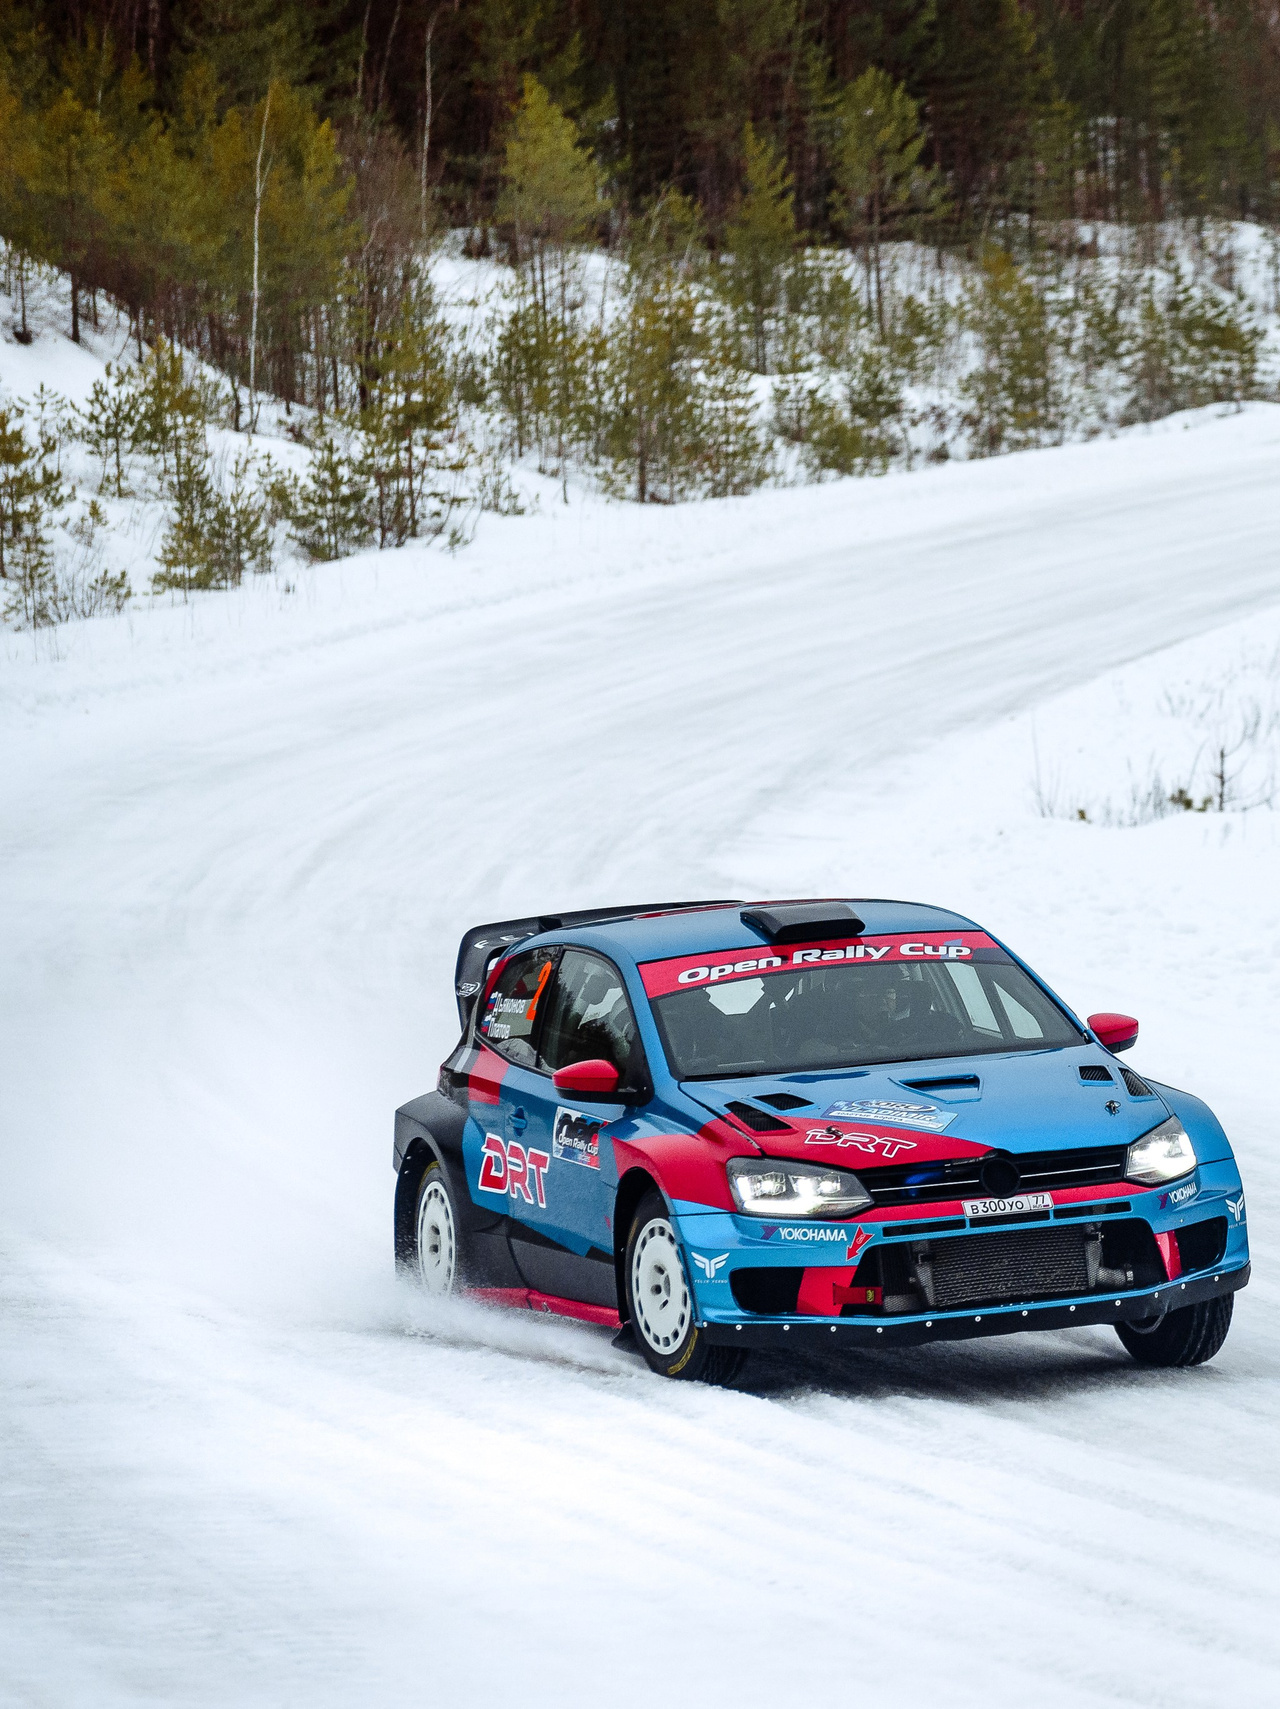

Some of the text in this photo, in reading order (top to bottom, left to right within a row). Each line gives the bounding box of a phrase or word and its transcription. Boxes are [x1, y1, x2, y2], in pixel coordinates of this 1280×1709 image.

[677, 943, 972, 984] Open Rally Cup
[526, 960, 552, 1021] 2
[842, 1105, 938, 1121] VLADIMIR
[558, 1133, 599, 1156] Open Rally Cup
[804, 1128, 918, 1158] DRT
[478, 1132, 550, 1208] DRT
[1032, 1194, 1045, 1206] 77
[1168, 1181, 1198, 1204] YOKOHAMA
[779, 1227, 848, 1242] YOKOHAMA
